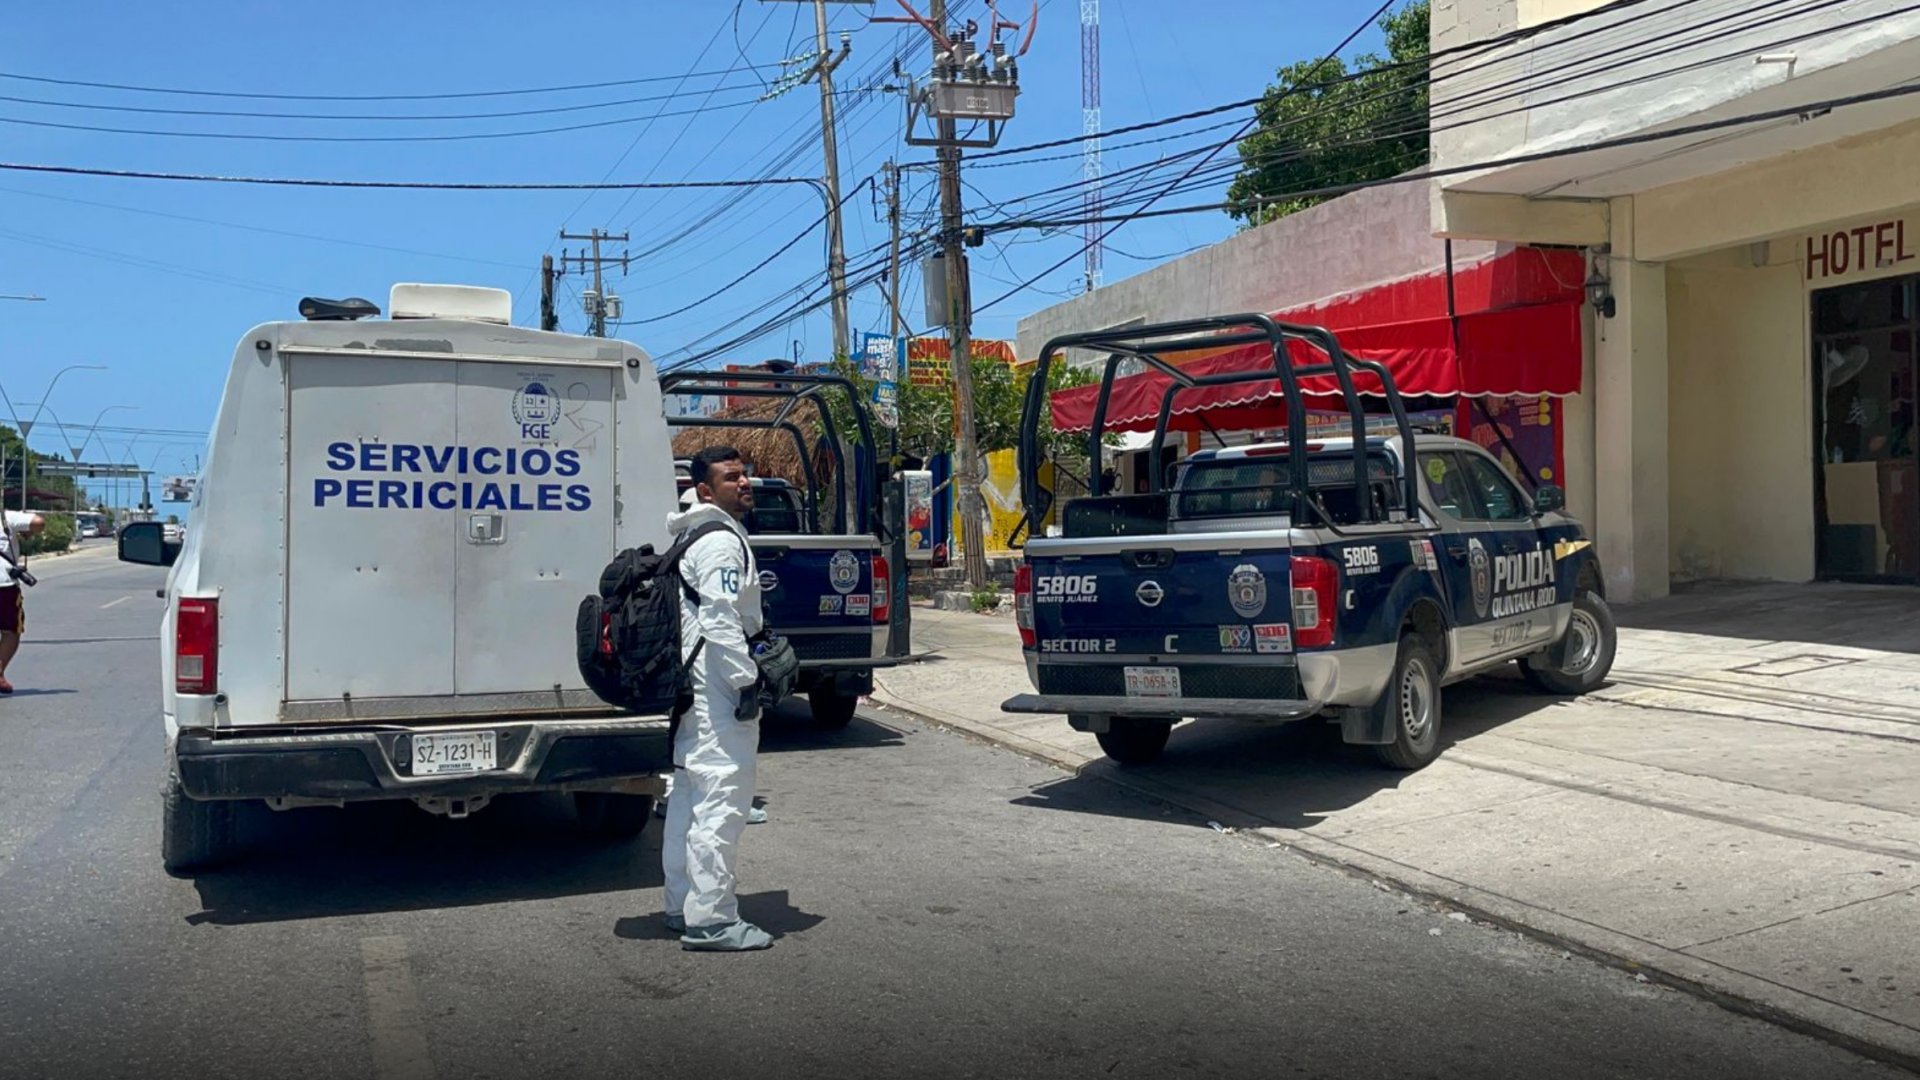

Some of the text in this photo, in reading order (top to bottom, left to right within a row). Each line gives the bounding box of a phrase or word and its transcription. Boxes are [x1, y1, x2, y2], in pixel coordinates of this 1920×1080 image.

[1805, 219, 1916, 280] HOTEL
[521, 422, 551, 440] FGE
[325, 441, 582, 477] SERVICIOS
[313, 478, 593, 512] PERICIALES
[1342, 545, 1379, 568] 5806
[1493, 540, 1556, 594] POLICÍA
[1036, 574, 1098, 596] 5806
[1036, 595, 1065, 603] BENITO
[1345, 589, 1356, 610] C
[1492, 586, 1557, 619] QUINTANA ROO
[1041, 638, 1117, 652] SECTOR 2
[1163, 634, 1180, 654] C
[1220, 628, 1251, 648] 089
[417, 741, 493, 764] SZ-1231-H
